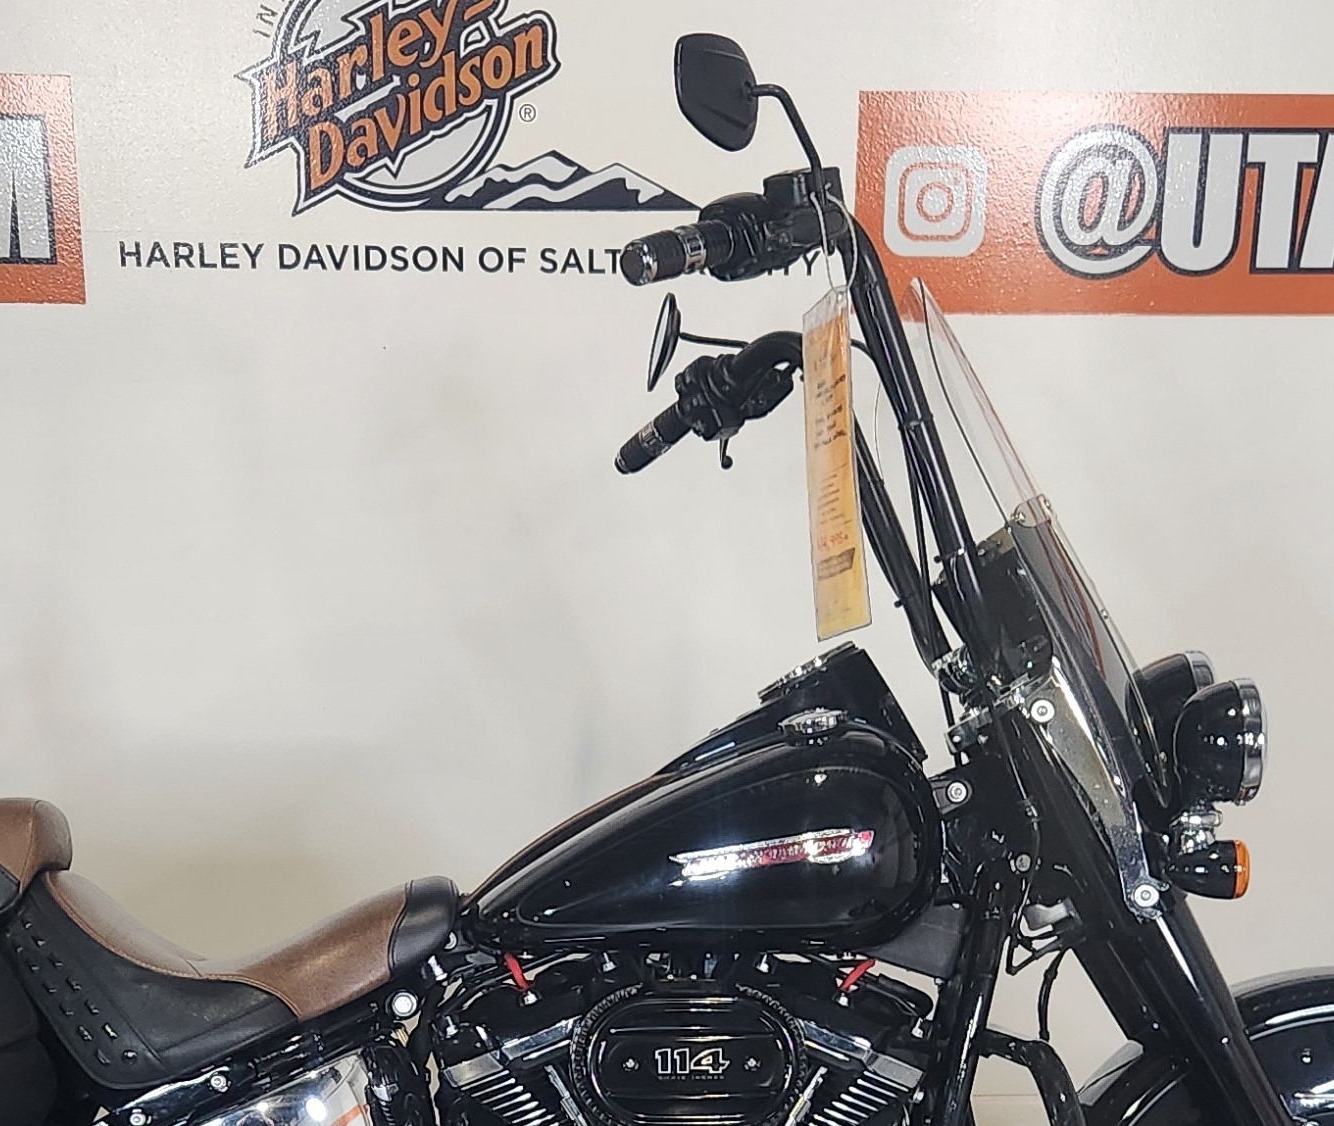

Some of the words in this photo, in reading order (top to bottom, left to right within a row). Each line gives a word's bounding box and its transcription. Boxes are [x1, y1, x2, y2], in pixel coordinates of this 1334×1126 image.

[309, 24, 544, 190] Davidson
[118, 240, 264, 270] HARLEY
[278, 243, 464, 273] DAVIDSON
[478, 246, 527, 273] OF
[539, 247, 621, 275] SALT
[655, 1047, 731, 1074] 114
